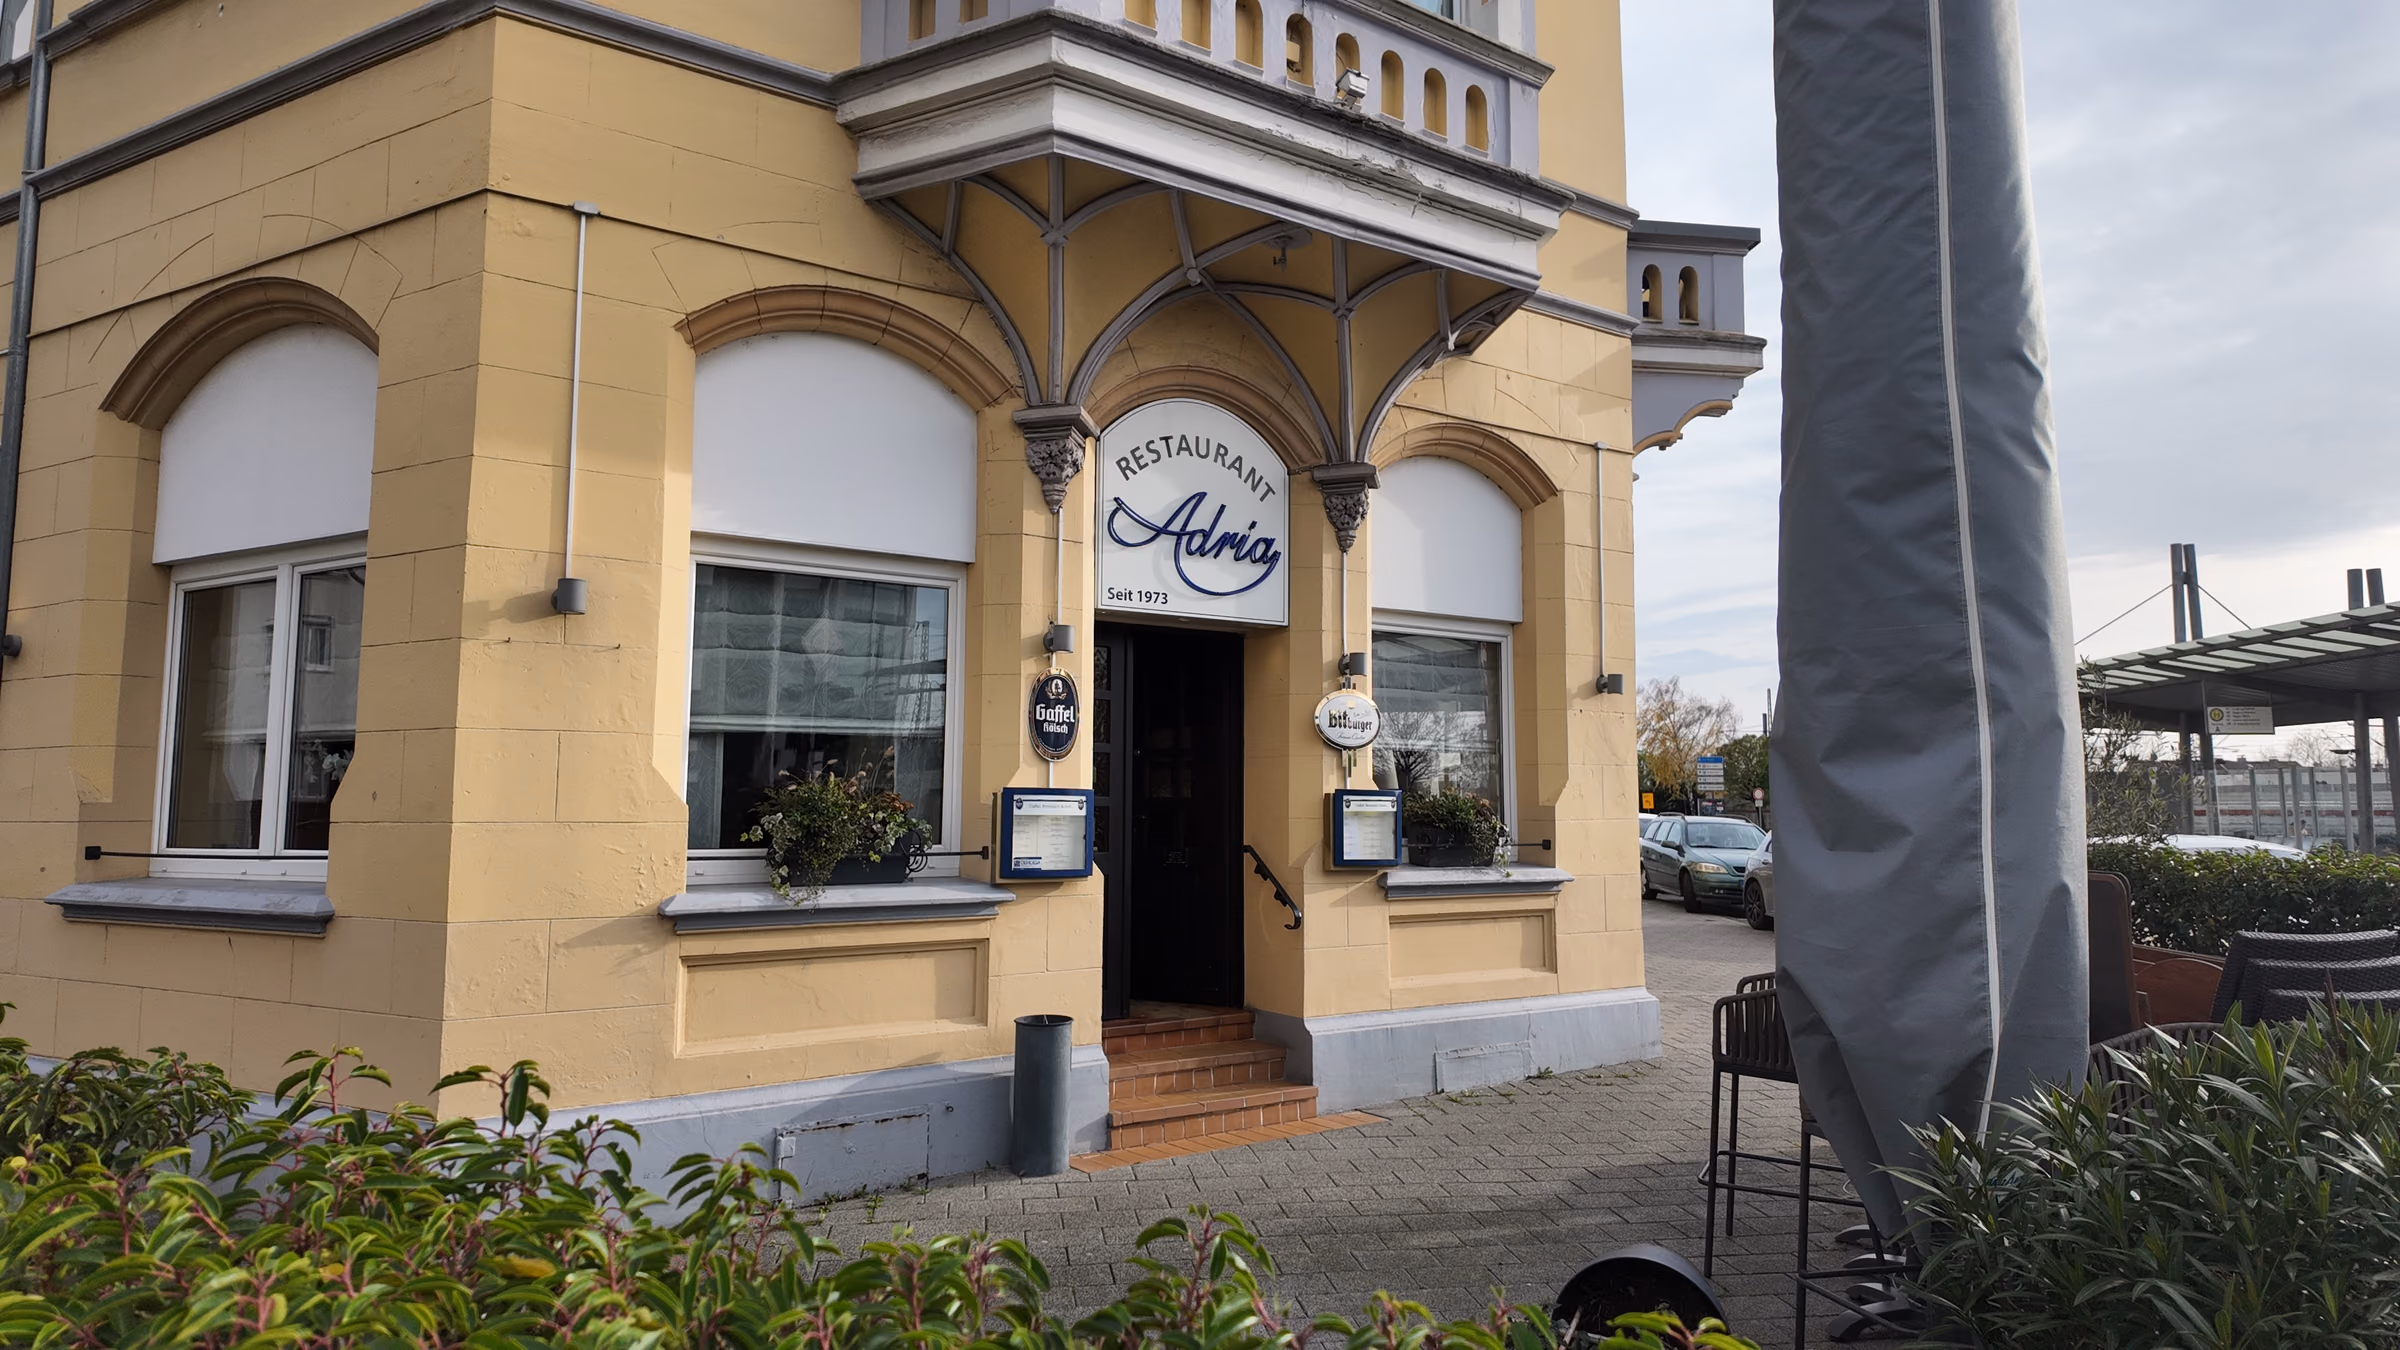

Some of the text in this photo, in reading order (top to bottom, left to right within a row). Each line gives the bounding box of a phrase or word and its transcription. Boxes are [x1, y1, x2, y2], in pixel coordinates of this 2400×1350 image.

[1115, 434, 1276, 502] RESTAURANT
[1107, 491, 1281, 596] Adria
[1107, 587, 1168, 605] Seit 1973
[1035, 703, 1075, 723] Gaffel
[1328, 709, 1372, 733] Bitburger
[1043, 721, 1068, 734] Kölsch
